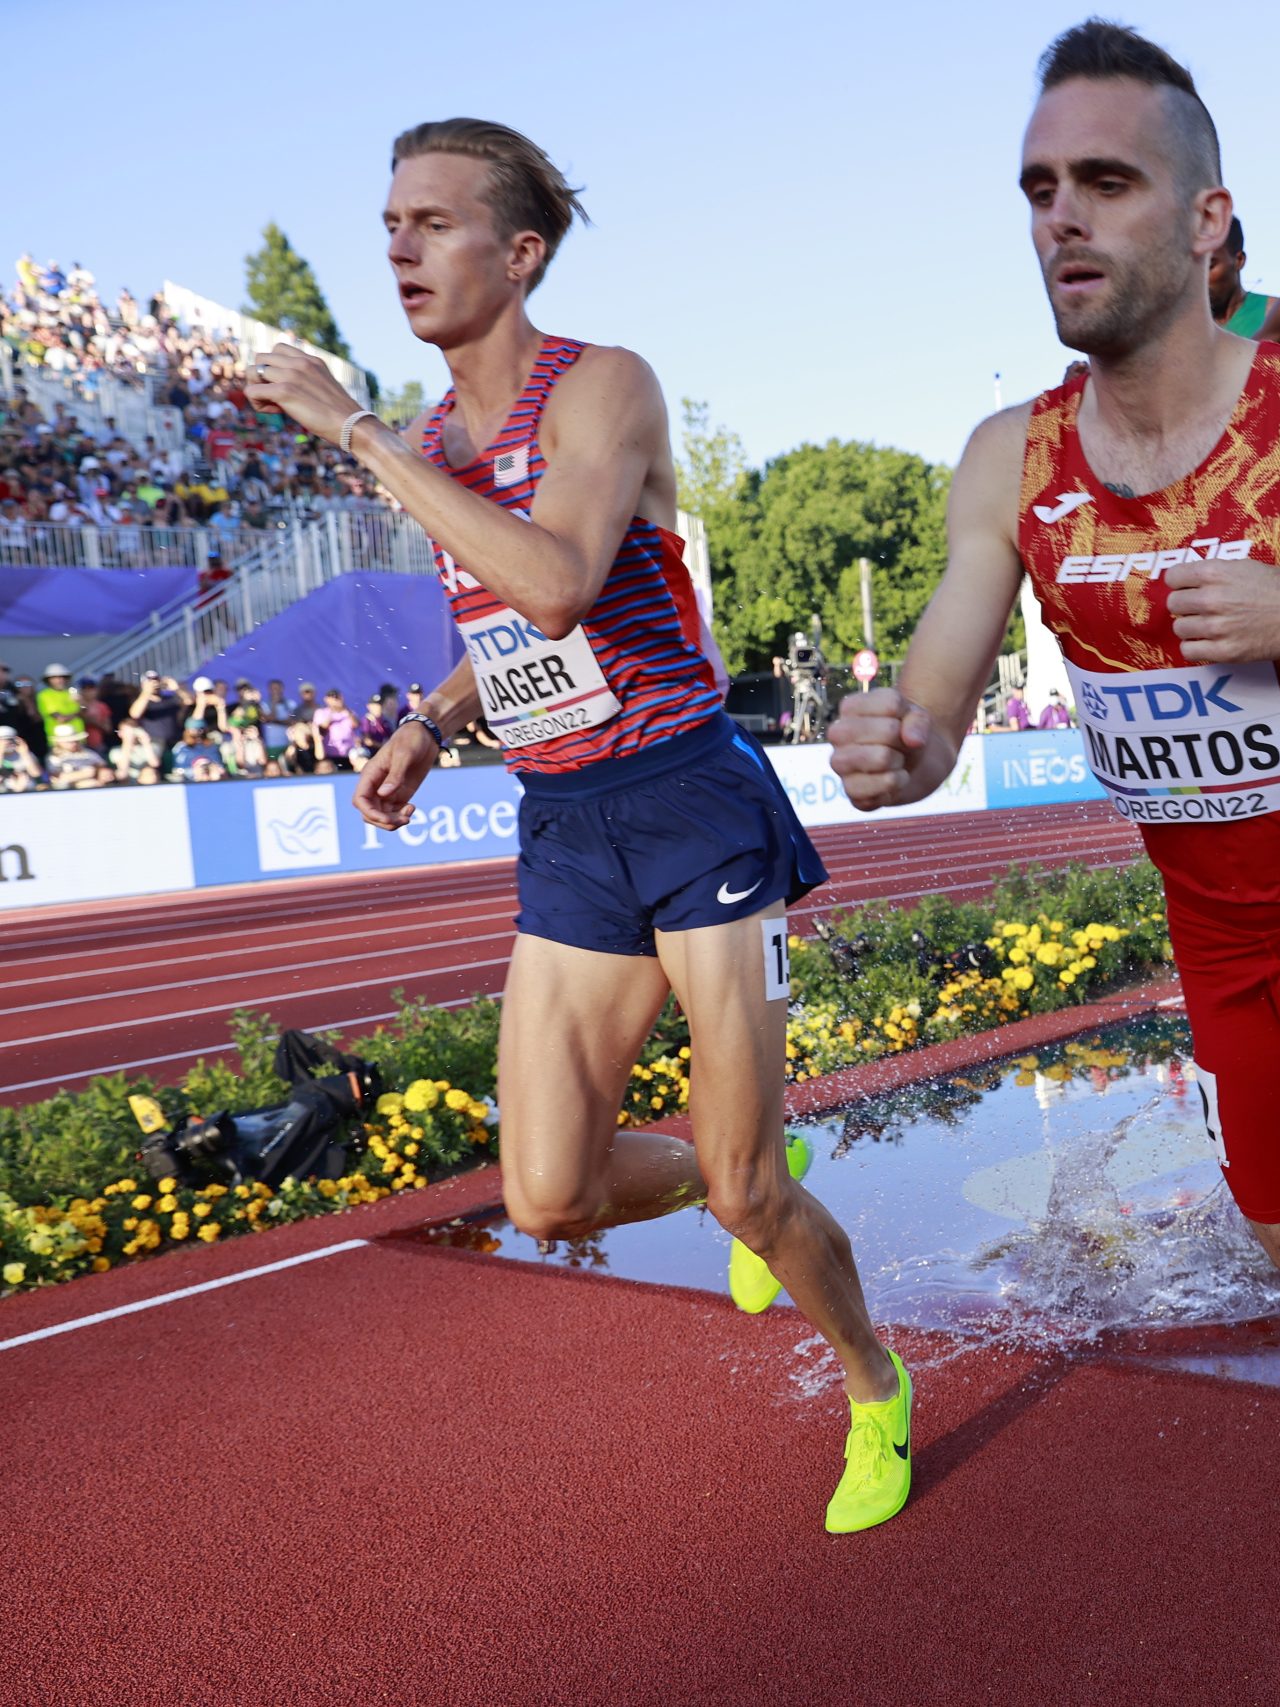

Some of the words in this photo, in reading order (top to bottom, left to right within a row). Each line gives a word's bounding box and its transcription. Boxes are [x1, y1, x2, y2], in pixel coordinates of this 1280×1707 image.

[470, 619, 550, 661] TDK
[481, 653, 577, 713] JAGER
[1102, 673, 1244, 721] TDK
[504, 707, 593, 746] OREGON22
[1001, 754, 1088, 789] INEOS
[1086, 724, 1280, 780] MARTOS
[1115, 793, 1269, 821] OREGON22
